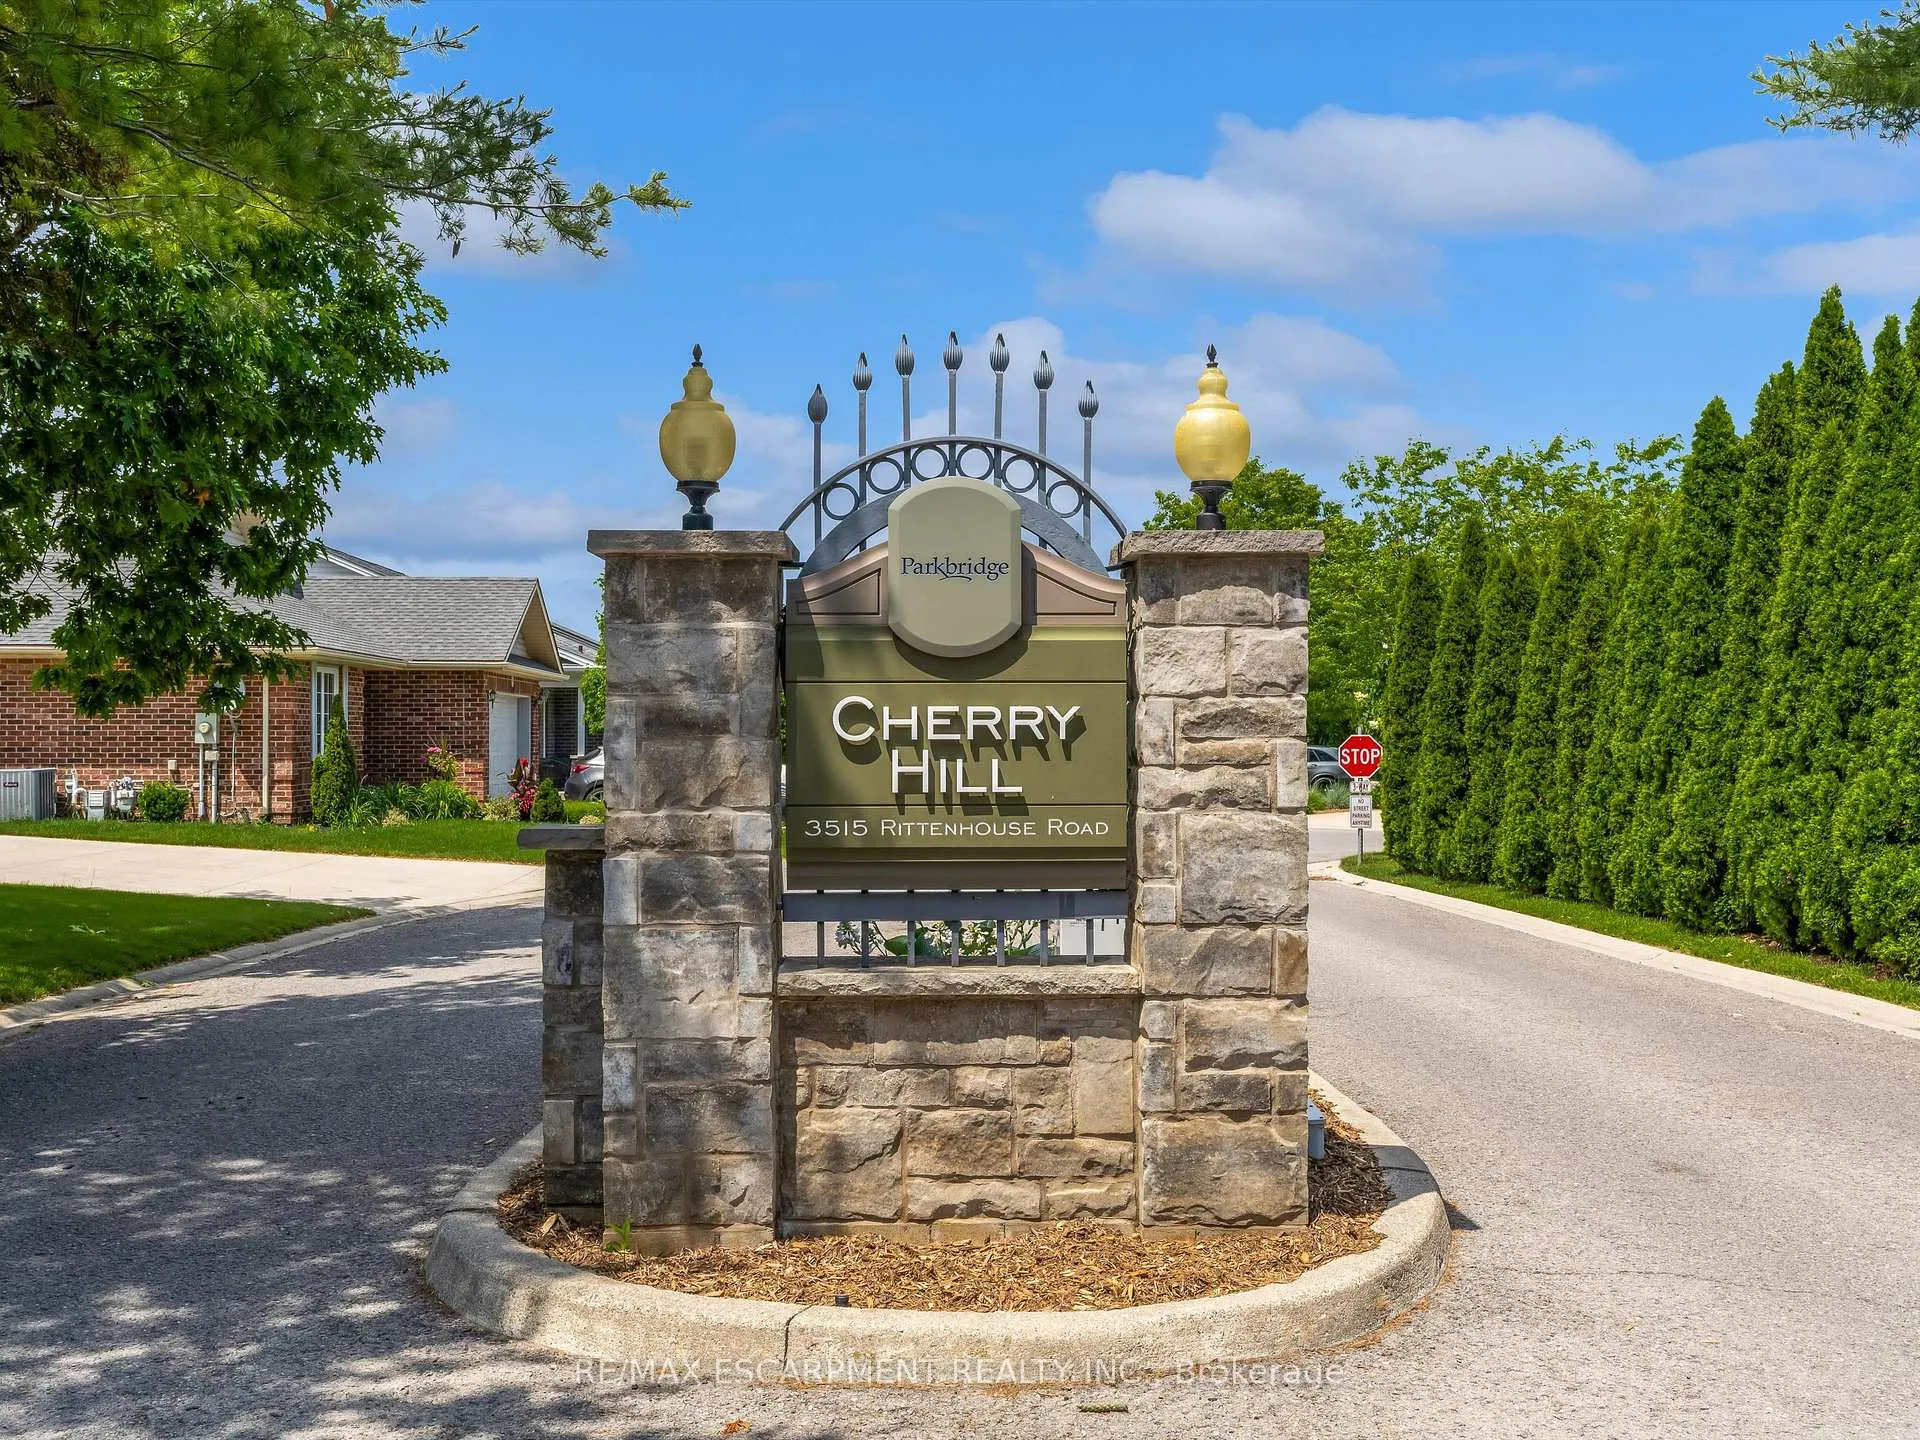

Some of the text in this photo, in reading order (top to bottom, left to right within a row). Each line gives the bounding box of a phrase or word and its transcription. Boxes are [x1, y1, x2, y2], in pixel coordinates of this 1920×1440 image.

[901, 556, 1009, 582] Parkbridge
[832, 695, 1081, 741] CHERRY
[1341, 748, 1380, 765] STOP
[891, 749, 1023, 793] HILL
[804, 818, 1109, 837] 3515 RITTENHOUSE ROAD
